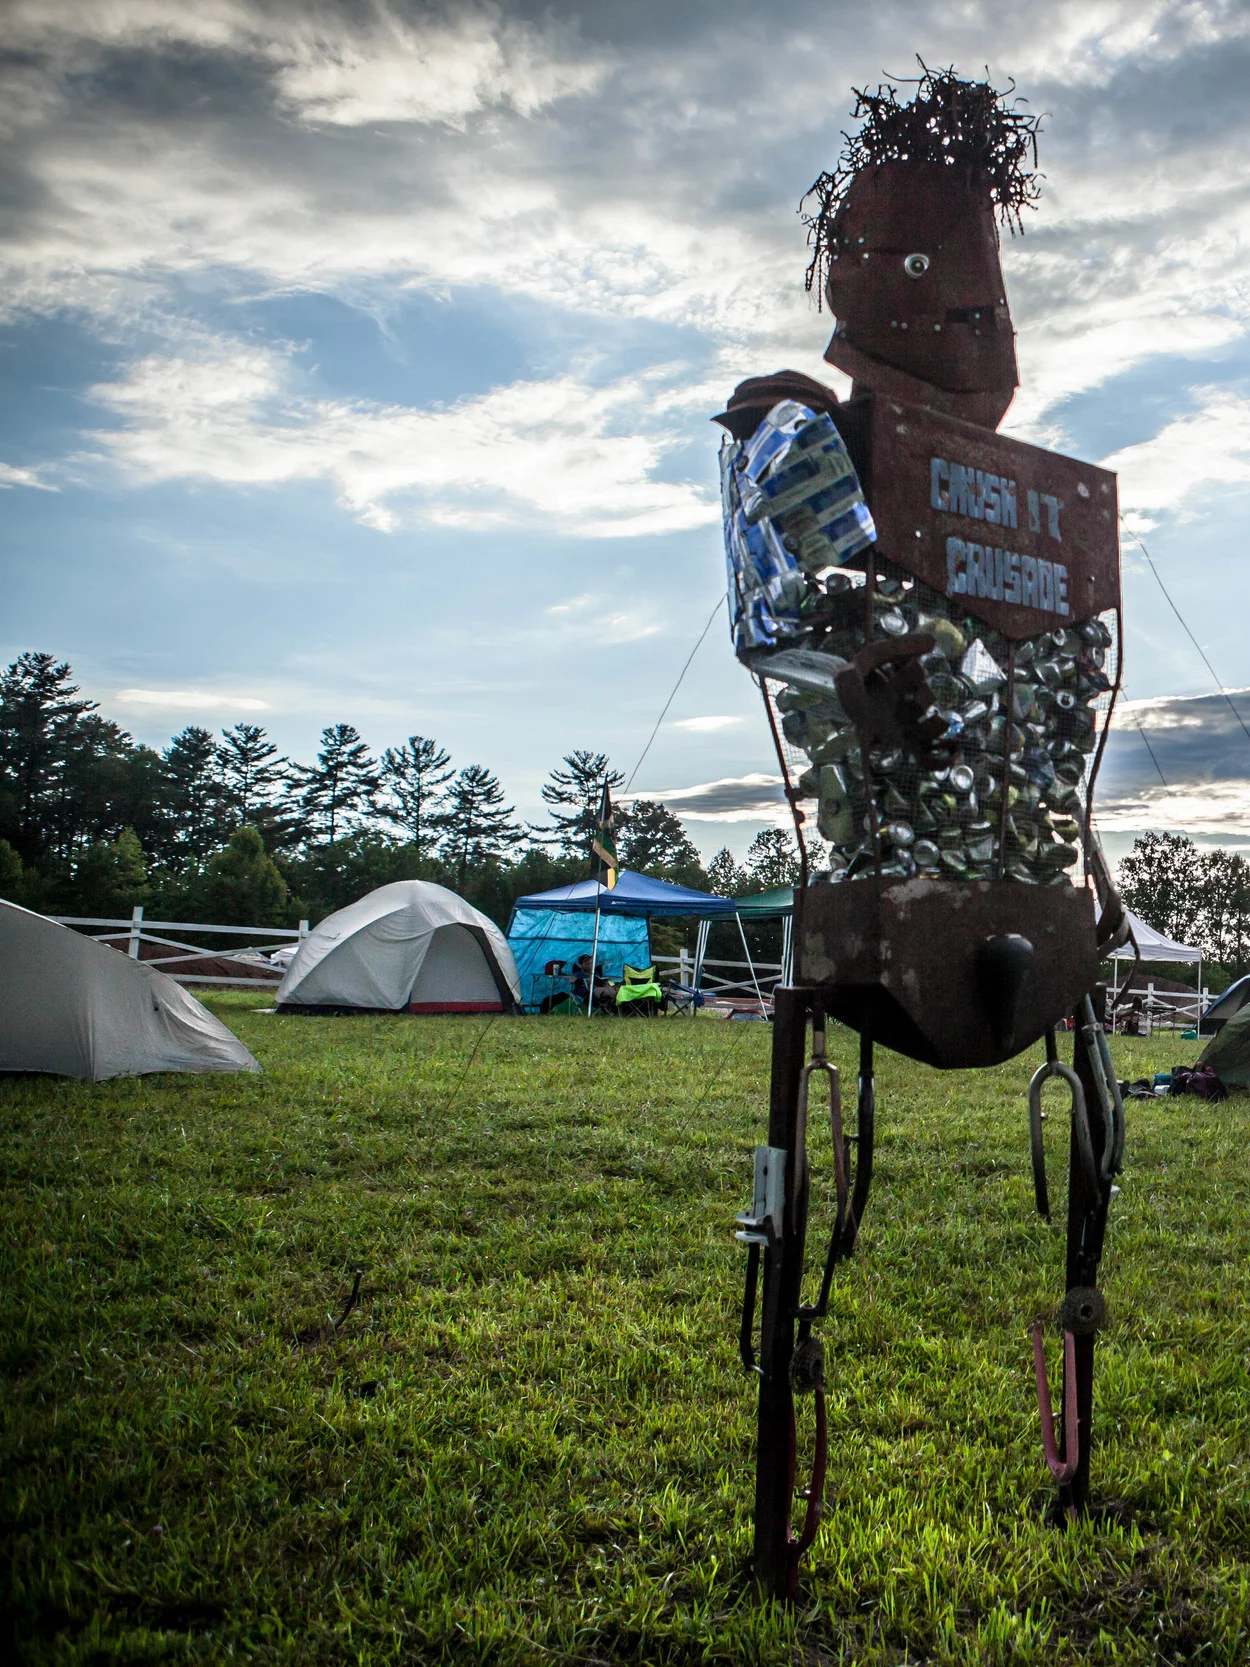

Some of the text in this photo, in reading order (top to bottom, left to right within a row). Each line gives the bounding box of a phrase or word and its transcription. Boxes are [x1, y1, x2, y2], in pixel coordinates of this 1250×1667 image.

[930, 457, 1064, 542] CRUSH IT
[946, 536, 1069, 616] CRUSADE
